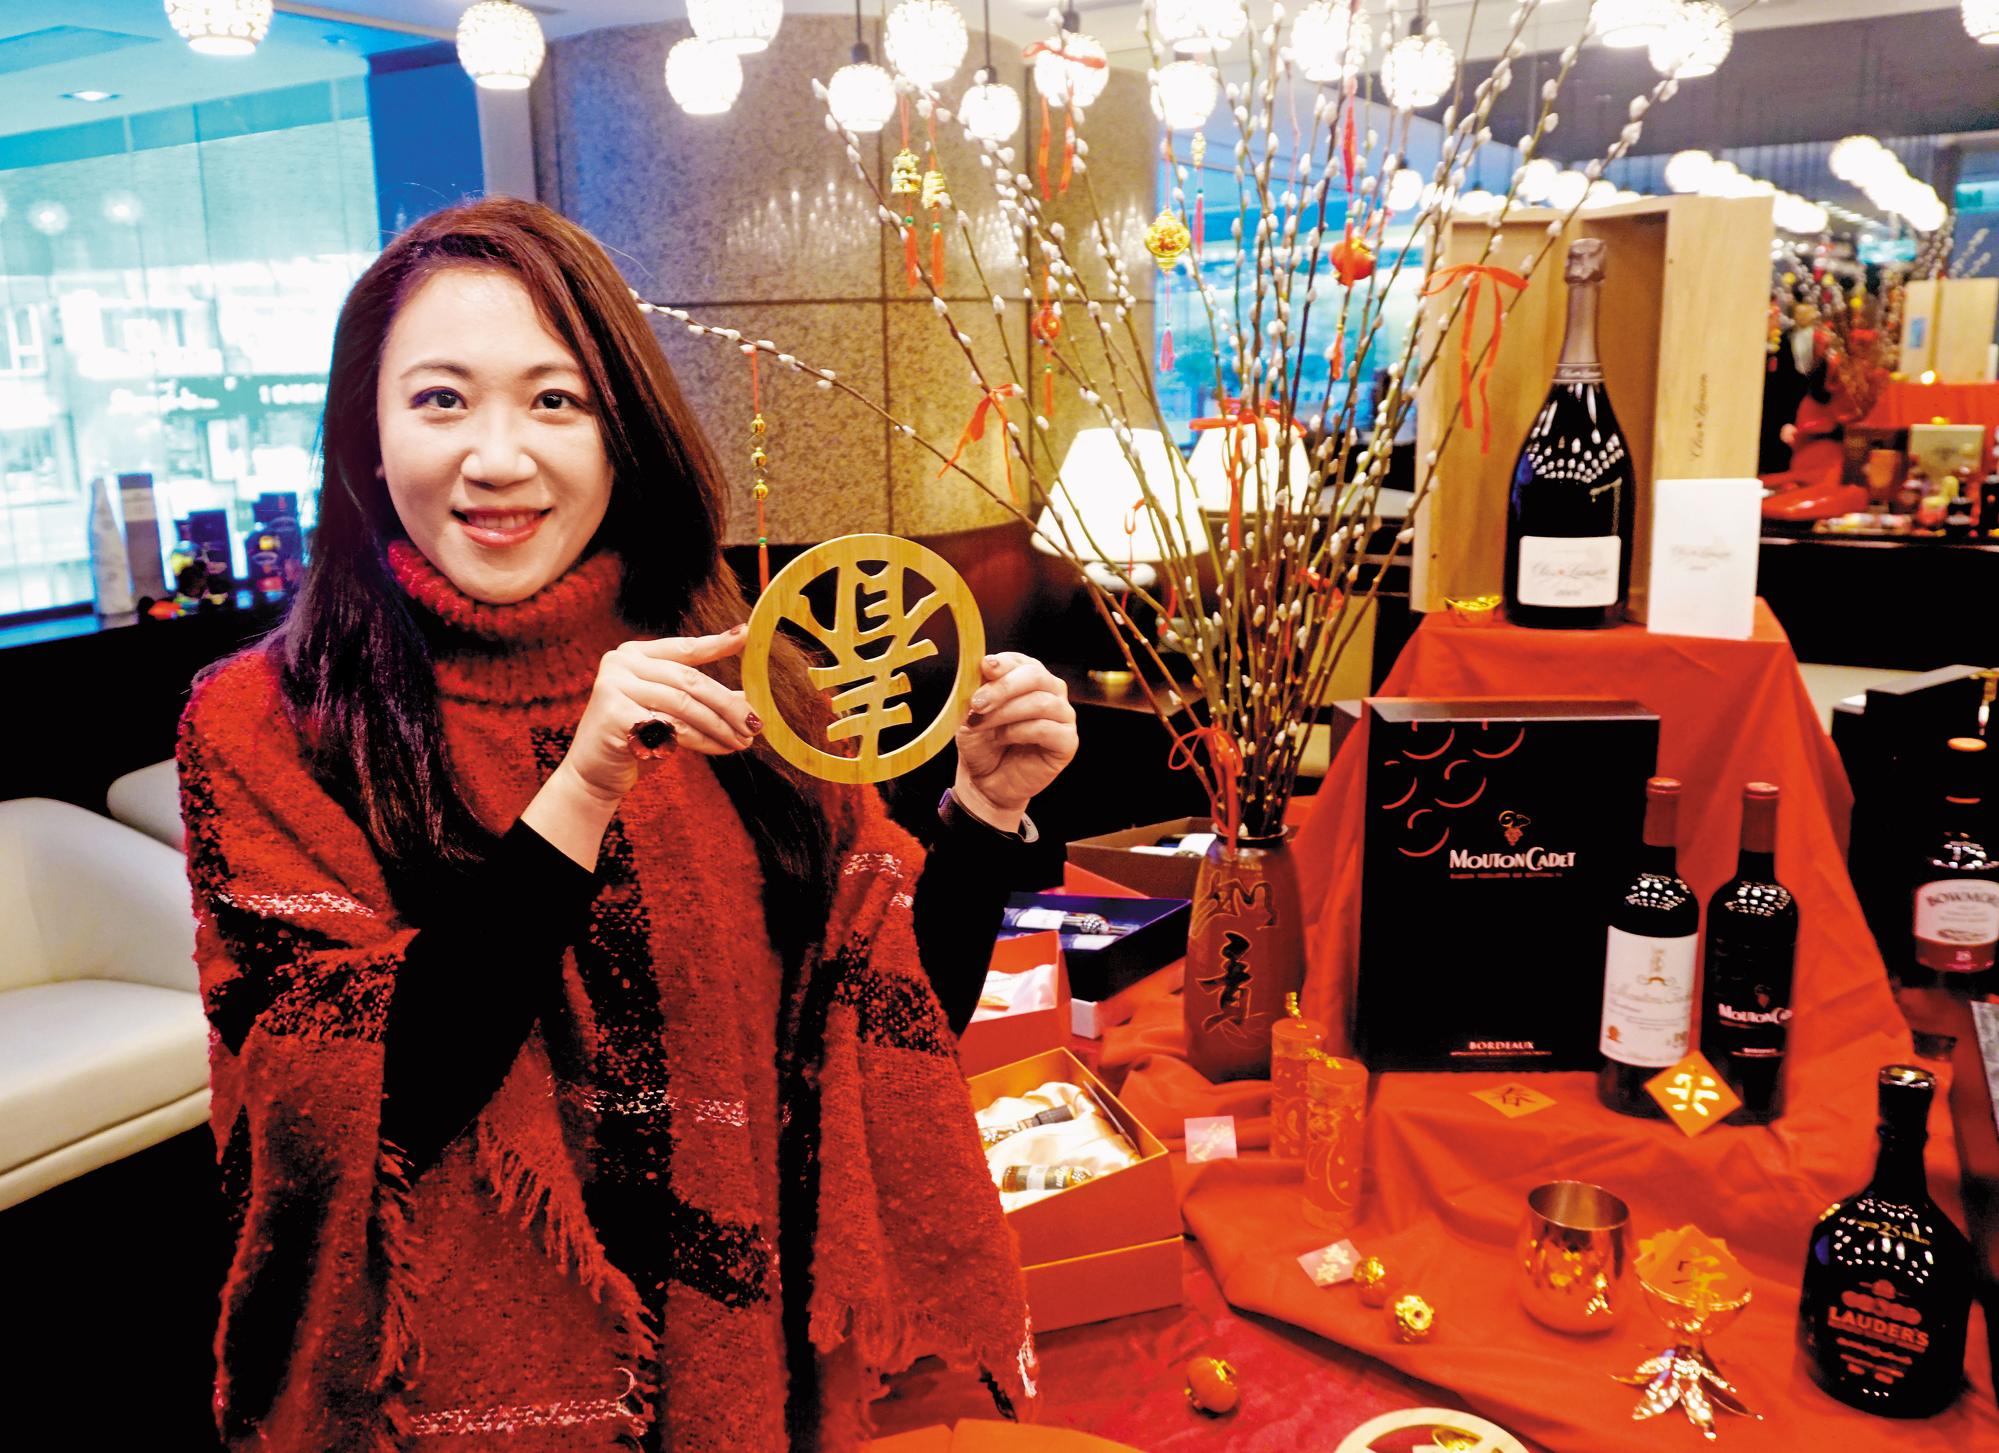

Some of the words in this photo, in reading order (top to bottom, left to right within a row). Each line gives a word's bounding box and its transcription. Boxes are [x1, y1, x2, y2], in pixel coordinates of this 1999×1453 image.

[1927, 891, 1999, 907] BOWMOR
[1468, 1040, 1535, 1050] BORDEAUX
[1827, 1305, 1930, 1348] LAUDER'S
